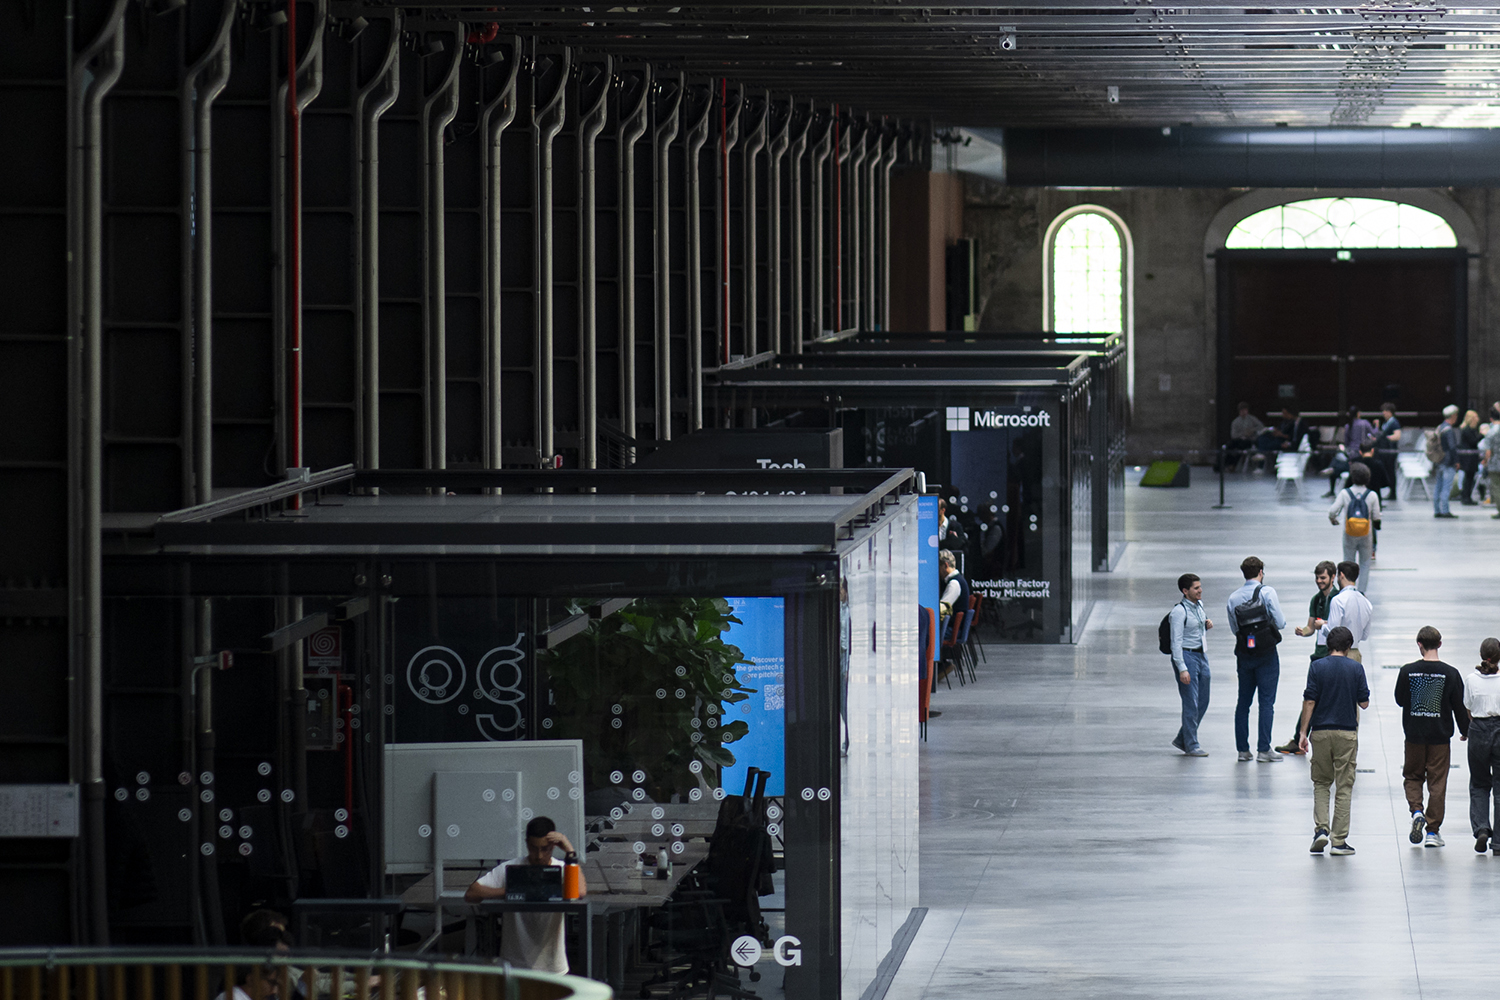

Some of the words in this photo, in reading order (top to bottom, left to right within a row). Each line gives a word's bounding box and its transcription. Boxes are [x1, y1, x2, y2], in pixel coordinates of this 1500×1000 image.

[973, 410, 1051, 427] Microsoft
[1017, 578, 1050, 589] Factory
[989, 589, 1002, 598] by
[1003, 588, 1050, 598] Microsoft
[748, 664, 779, 672] greentech
[773, 935, 802, 967] G
